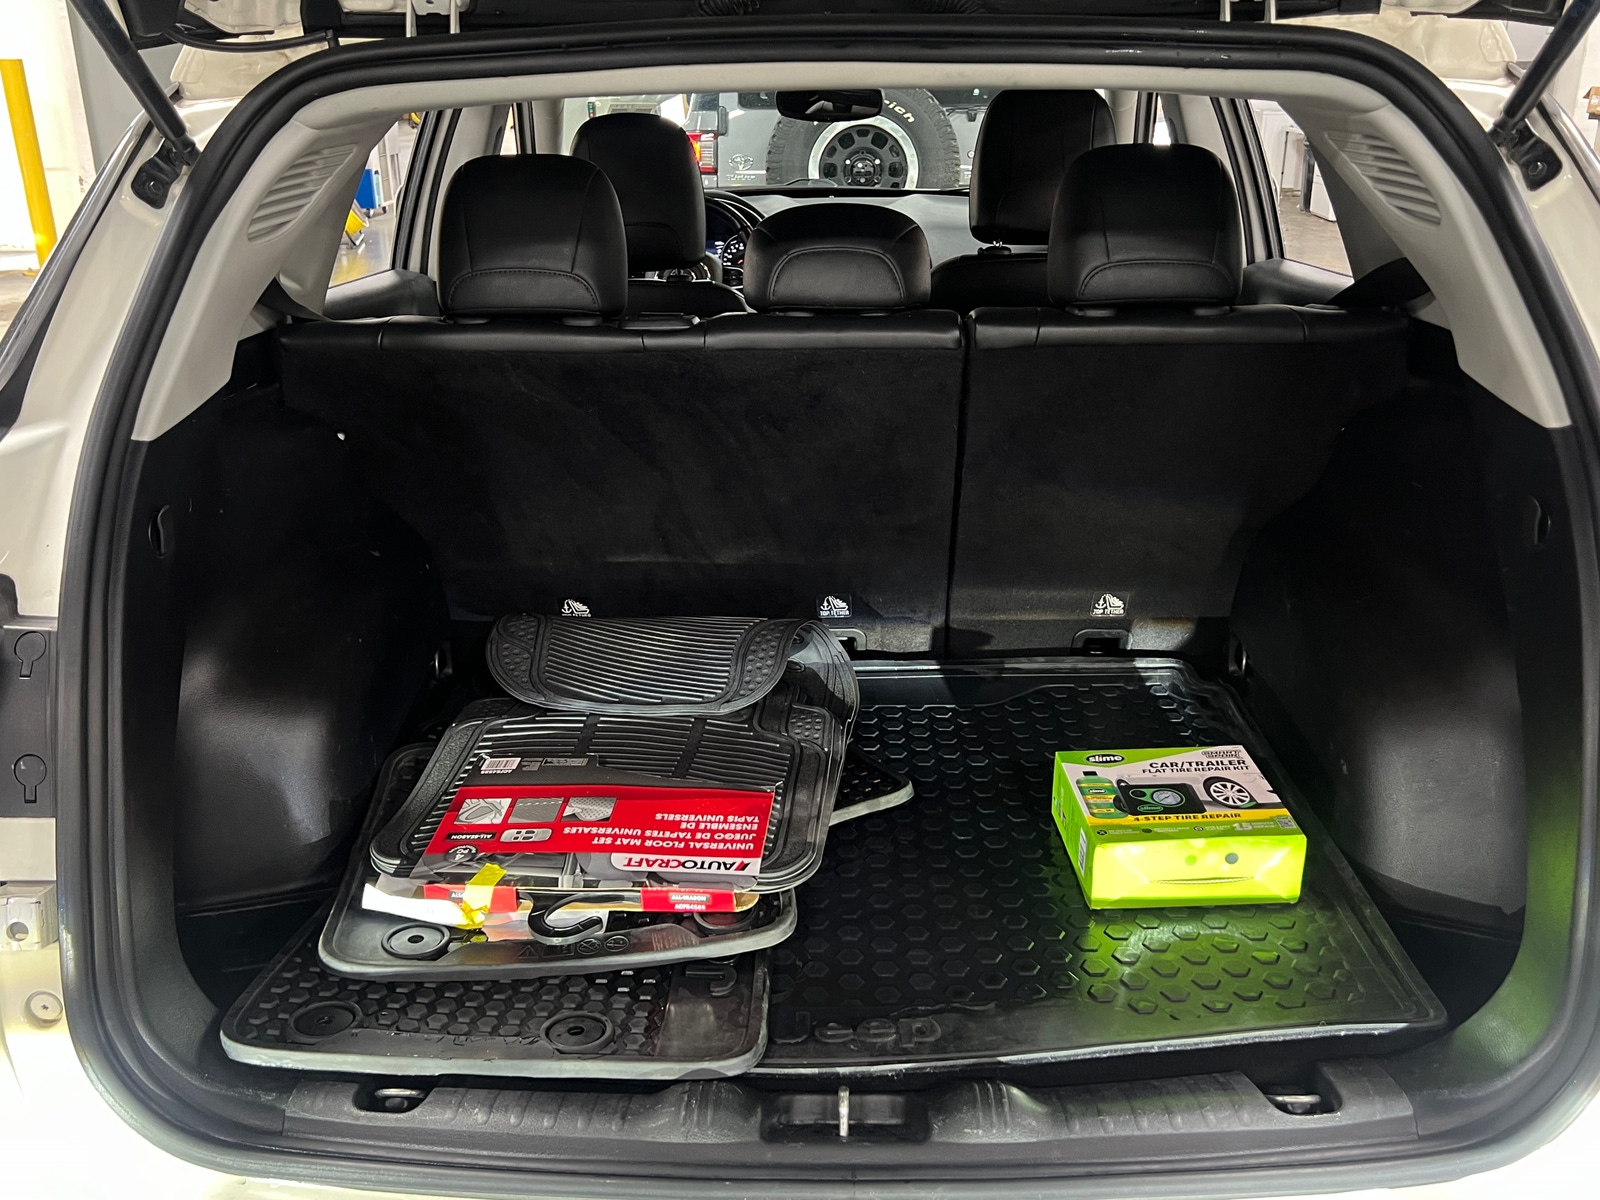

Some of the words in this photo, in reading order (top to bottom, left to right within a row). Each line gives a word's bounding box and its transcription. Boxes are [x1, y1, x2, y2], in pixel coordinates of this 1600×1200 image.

[1088, 755, 1123, 763] slime
[1149, 759, 1247, 769] CAR/TRAILER
[655, 813, 724, 822] UNIVERSELS
[727, 815, 760, 823] TAPIS
[680, 821, 696, 829] DE
[698, 822, 758, 831] ENSEMBLE
[1232, 822, 1253, 831] 15
[563, 826, 642, 836] UNIVERSALES
[644, 829, 692, 839] TAPETES
[591, 836, 613, 844] SET
[695, 832, 711, 840] DE
[614, 837, 641, 846] MAT
[644, 839, 685, 848] FLOOR
[688, 841, 754, 850] UNIVERSAL
[623, 857, 738, 871] AUTOCRAFT
